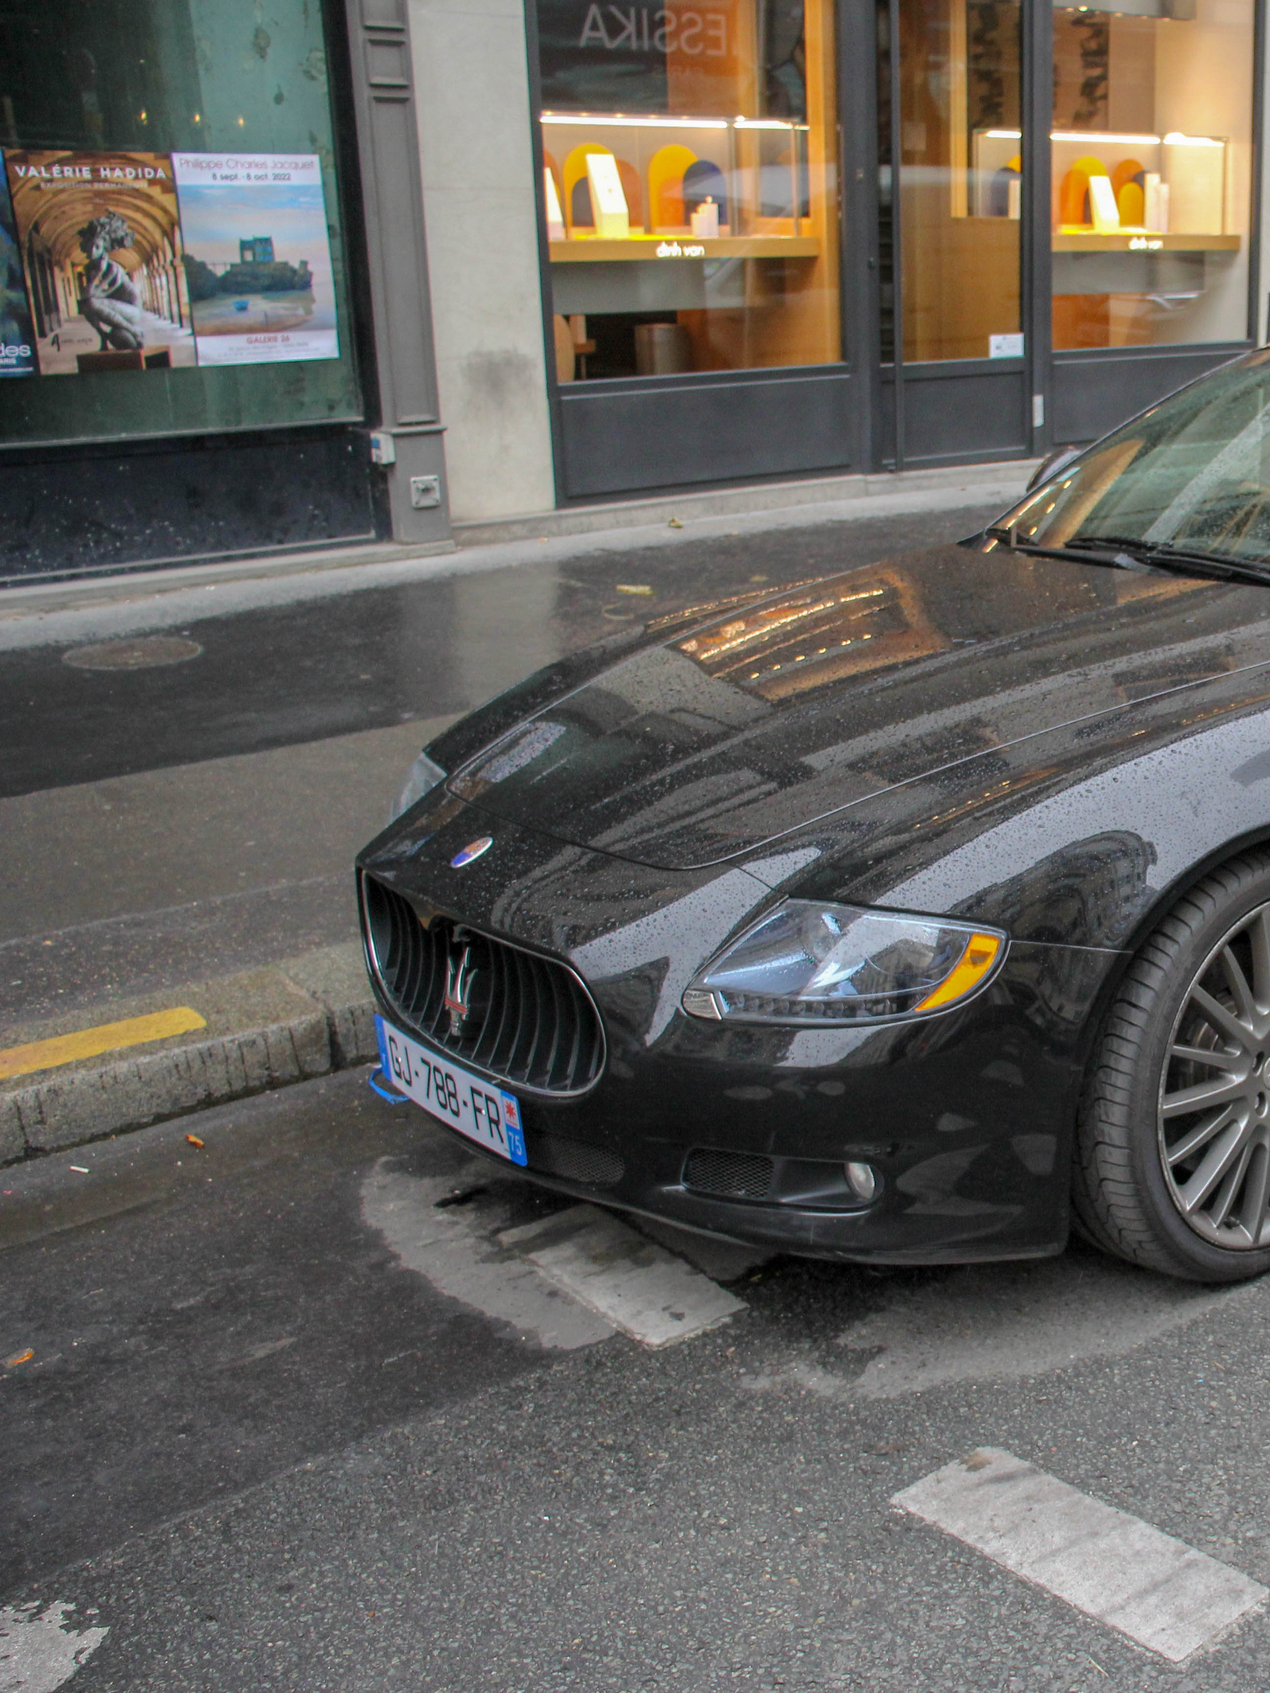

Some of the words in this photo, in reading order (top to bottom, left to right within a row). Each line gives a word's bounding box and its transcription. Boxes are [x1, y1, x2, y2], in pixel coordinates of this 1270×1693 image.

[179, 158, 223, 170] Philippe
[226, 158, 268, 169] Charles
[271, 159, 314, 170] Jacquet
[15, 164, 92, 179] VALÉRIE
[100, 167, 167, 179] HADIDA
[272, 173, 291, 181] 2022
[508, 1132, 522, 1156] 75
